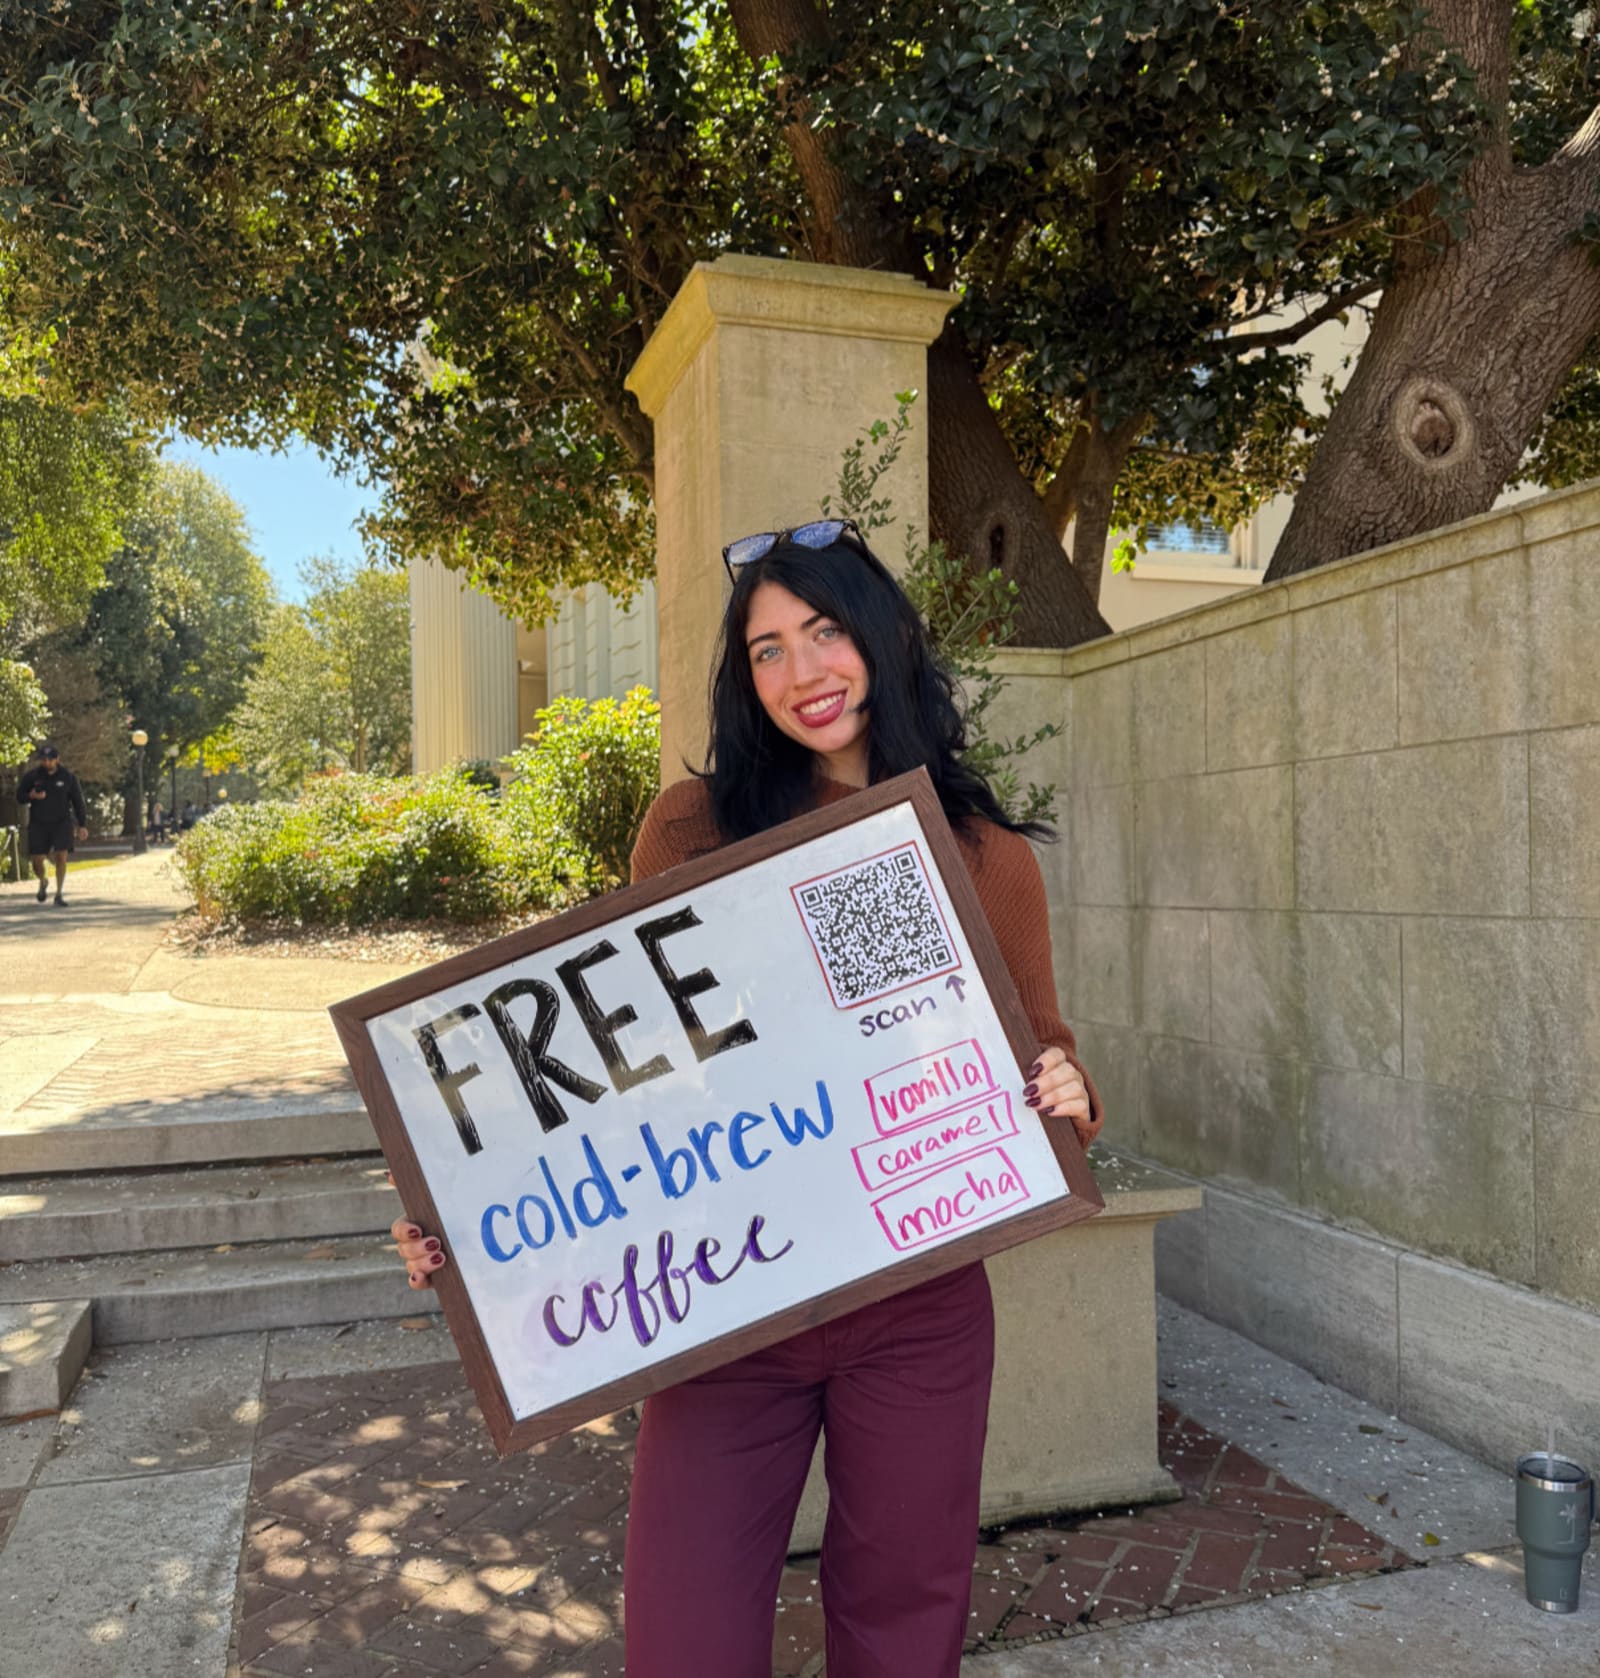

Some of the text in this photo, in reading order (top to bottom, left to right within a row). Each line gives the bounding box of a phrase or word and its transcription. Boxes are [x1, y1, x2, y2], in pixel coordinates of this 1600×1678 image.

[412, 905, 758, 1155] FREE
[859, 996, 936, 1037] scan
[880, 1057, 982, 1121] vanilla
[481, 1080, 833, 1262] cold-brew
[878, 1104, 1001, 1175] caramel
[898, 1171, 1018, 1241] mocha
[543, 1215, 793, 1347] coffee
